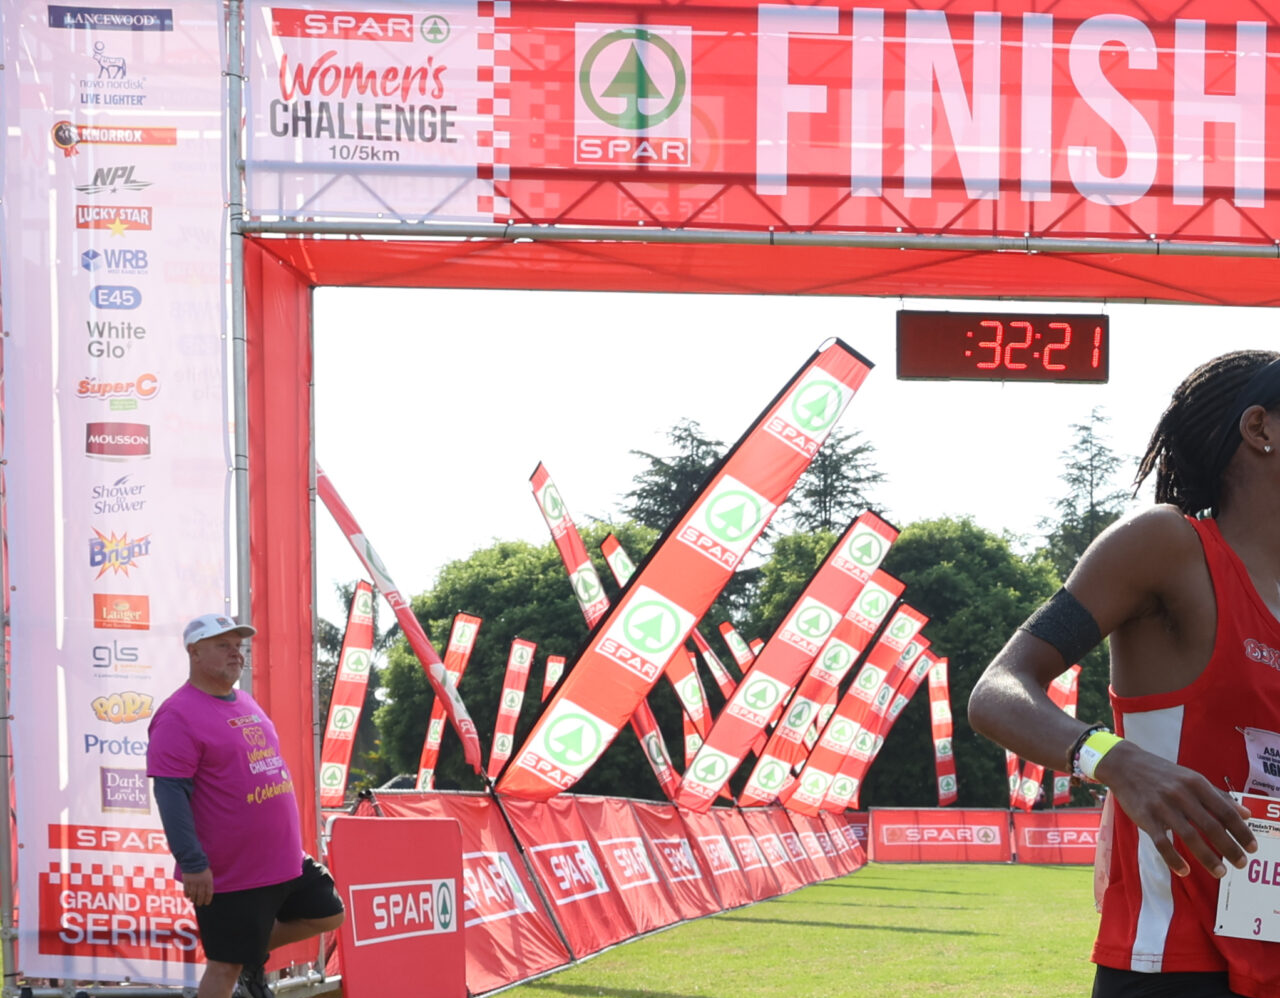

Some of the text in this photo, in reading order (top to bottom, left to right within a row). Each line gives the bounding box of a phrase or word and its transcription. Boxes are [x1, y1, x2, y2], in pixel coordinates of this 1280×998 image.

[66, 12, 155, 26] LANCEWOOD
[304, 14, 412, 38] SPAR
[80, 78, 144, 90] novo nordisk
[279, 50, 448, 103] Women's
[80, 93, 101, 105] LIVE
[756, 3, 1268, 208] FINISH
[269, 99, 458, 143] CHALLENGE
[82, 128, 143, 142] KNORROX
[328, 145, 400, 162] 10/5km
[580, 139, 685, 161] SPAR
[93, 165, 139, 186] NPL
[78, 207, 149, 225] LUCKY STAR
[103, 249, 148, 269] WRB
[98, 290, 134, 306] E45
[87, 321, 146, 339] White
[87, 341, 125, 359] Glo
[88, 434, 149, 445] MOUSSON
[770, 418, 818, 454] SPAR
[91, 484, 146, 499] Shower
[93, 500, 147, 515] Shower
[88, 536, 151, 568] Bright
[683, 528, 738, 566] SPAR
[833, 556, 870, 583] SPAR
[102, 607, 142, 621] Laager
[847, 609, 878, 632] SPAR
[781, 629, 819, 656] SPAR
[93, 639, 139, 668] gls
[600, 639, 658, 679] SPAR
[730, 703, 766, 726] SPAR
[106, 772, 144, 788] Dark
[521, 752, 577, 788] SPAR
[106, 788, 147, 805] Lovely
[76, 829, 170, 850] SPAR
[906, 828, 972, 842] SPAR
[1047, 831, 1100, 844] SPA
[550, 850, 596, 890] SPAR
[613, 848, 651, 878] SPAR
[59, 889, 196, 916] GRAND PRIX
[372, 891, 434, 930] SPAR
[58, 911, 199, 951] SERIES
[1252, 917, 1262, 936] 3
